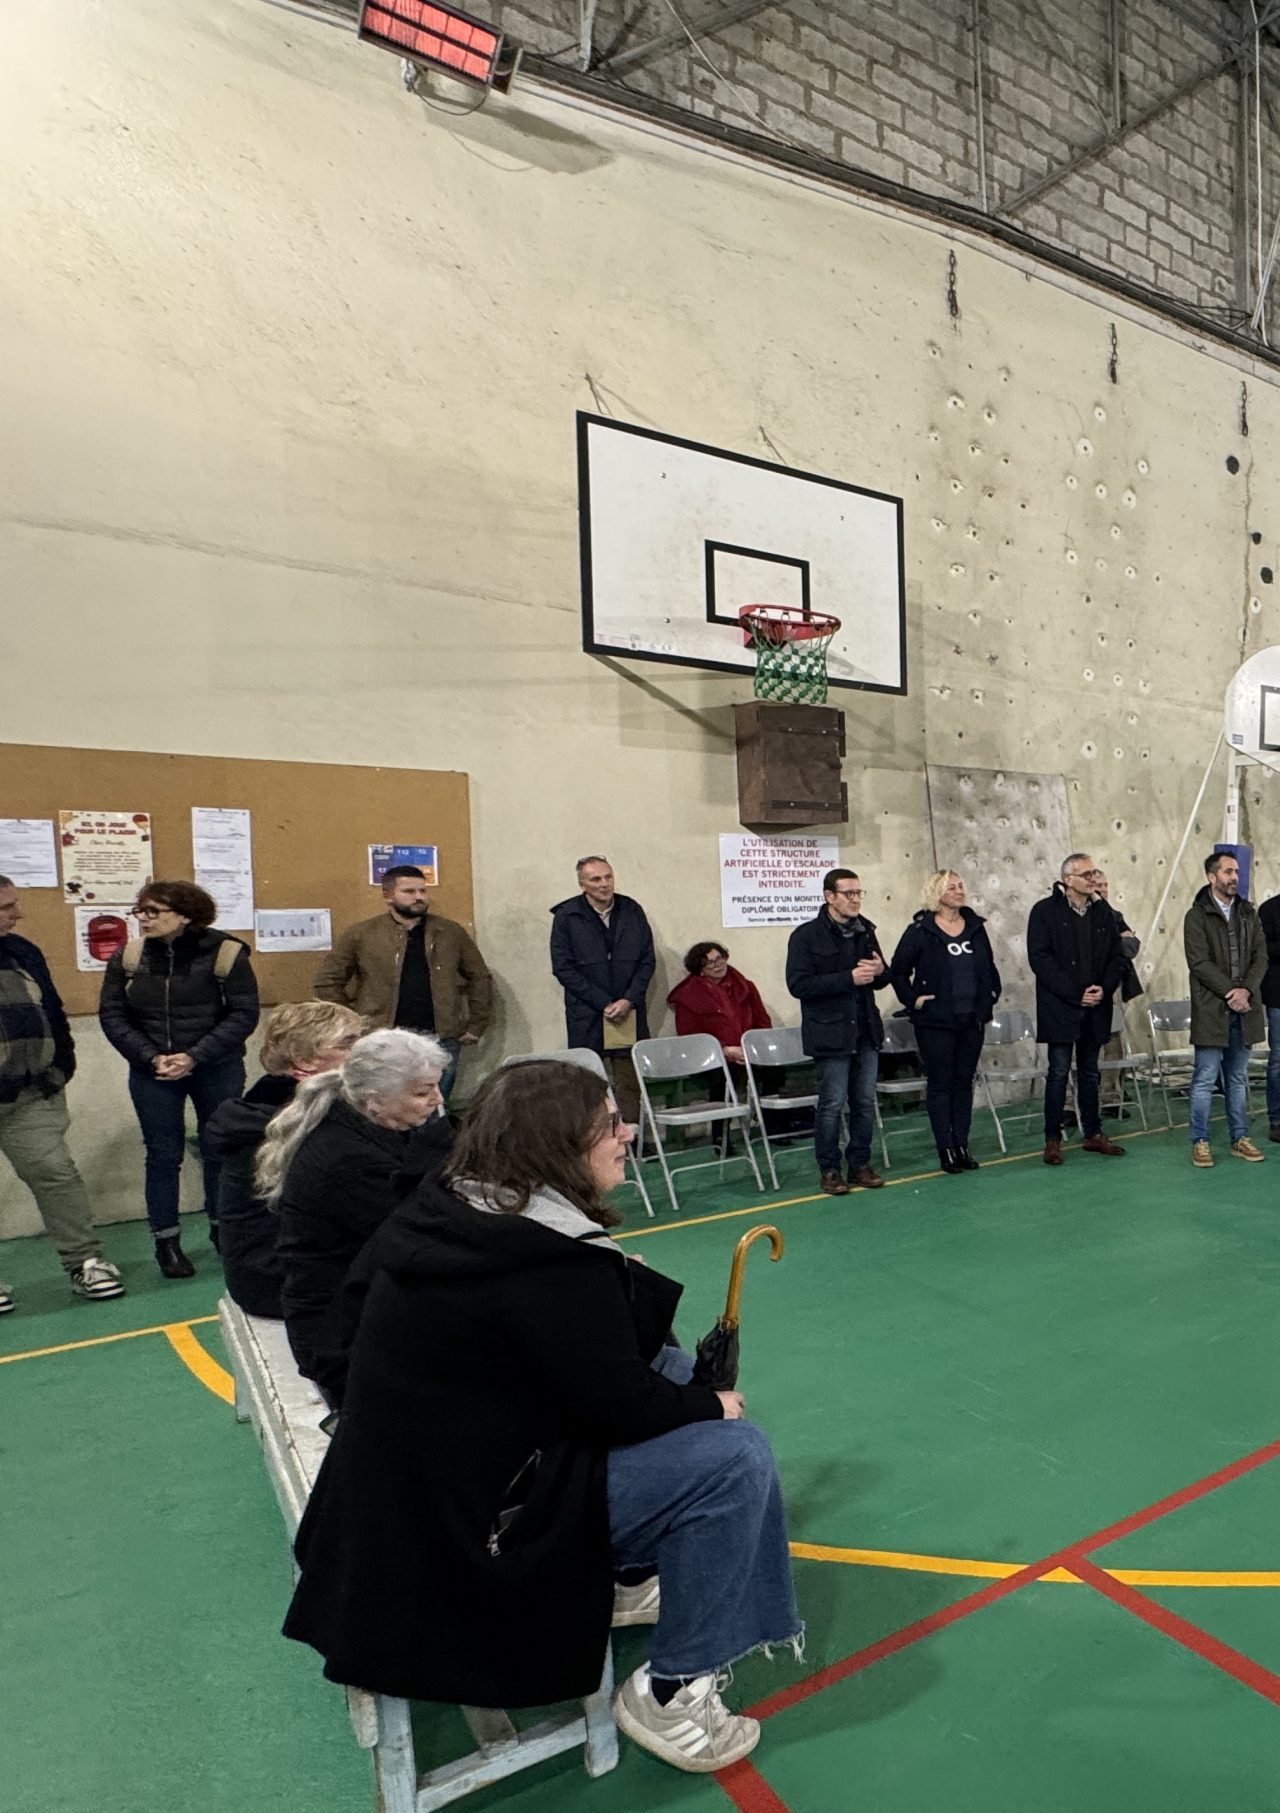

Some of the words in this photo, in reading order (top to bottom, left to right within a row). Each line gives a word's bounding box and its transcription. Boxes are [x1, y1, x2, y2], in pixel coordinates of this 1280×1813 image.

[743, 839, 804, 848] L'UTILISATION
[806, 839, 818, 848] DE
[740, 849, 769, 858] CETTE
[770, 849, 821, 858] STRUCTURE
[724, 859, 782, 868] ARTIFICIELLE
[785, 859, 836, 868] D'ESCALADE
[742, 870, 759, 878] EST
[761, 870, 821, 878] STRICTEMENT
[758, 880, 807, 889] INTERDITE.
[732, 895, 772, 903] PRÉSENCE
[774, 895, 793, 903] D'UN
[794, 895, 826, 903] MONITEU
[741, 904, 774, 914] DIPLÔMÉ
[947, 940, 974, 956] OC
